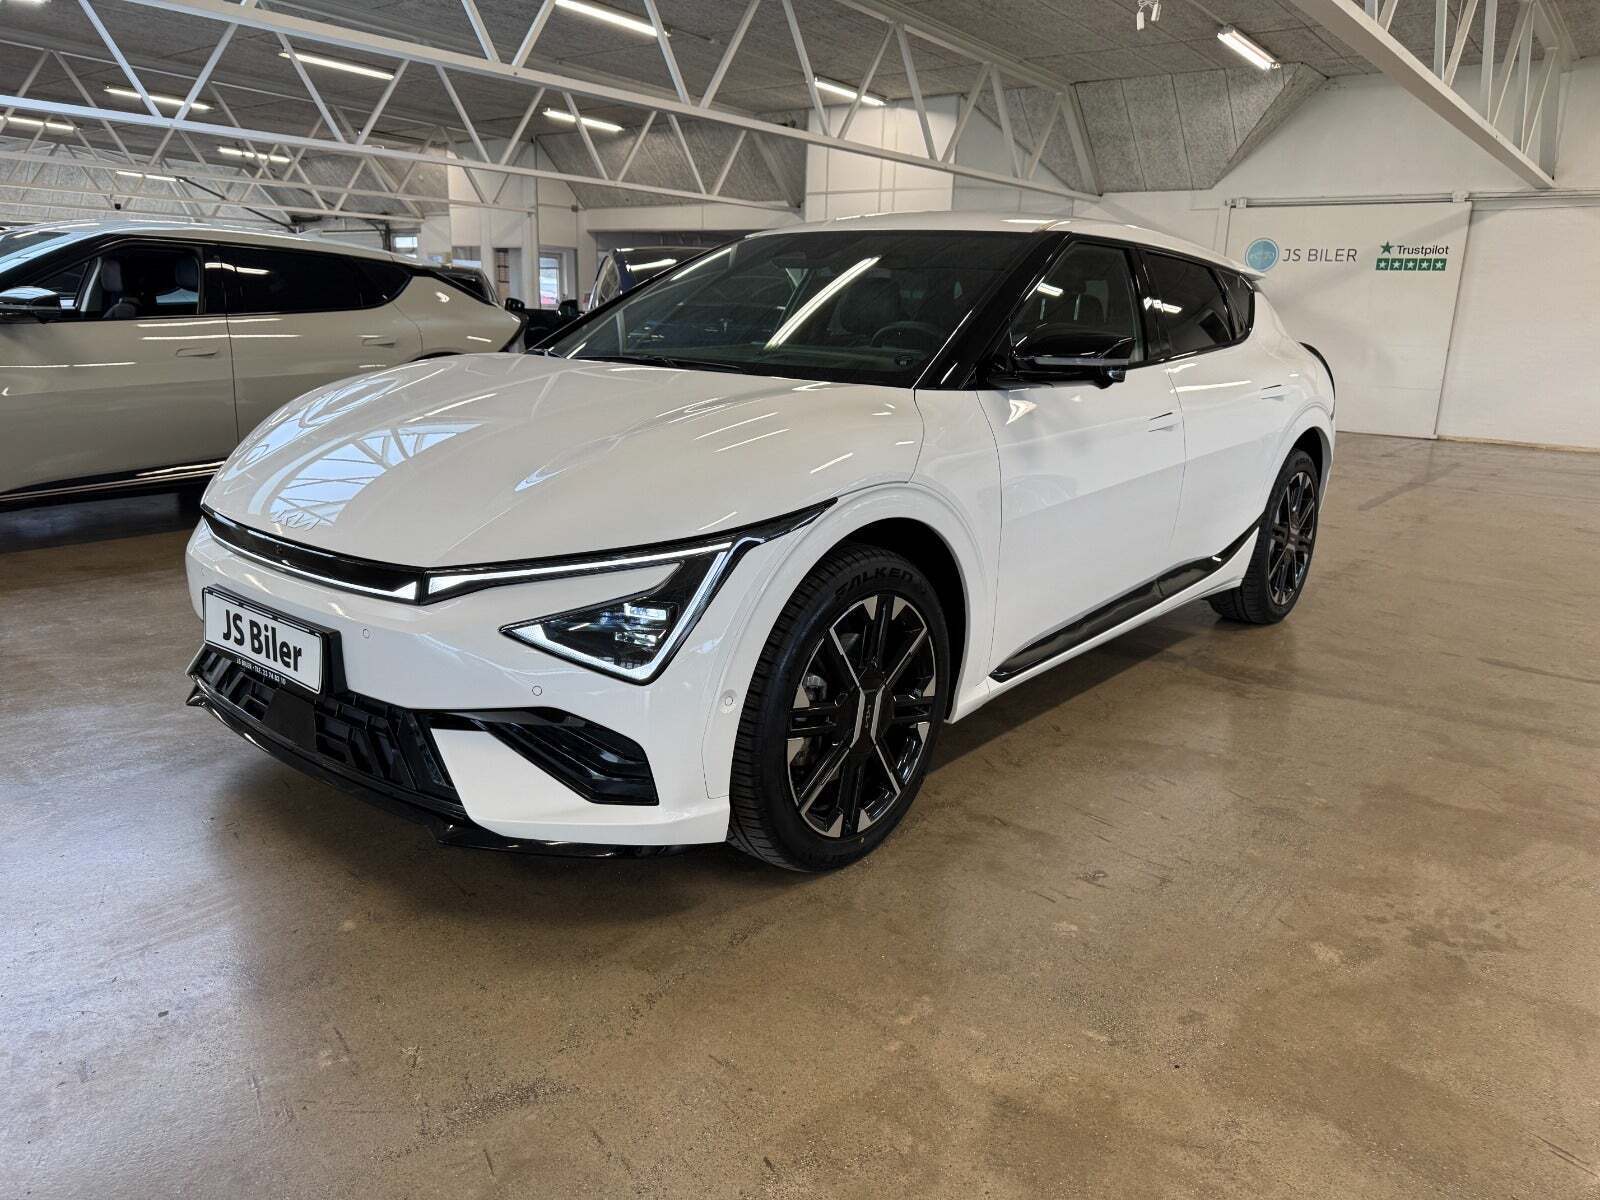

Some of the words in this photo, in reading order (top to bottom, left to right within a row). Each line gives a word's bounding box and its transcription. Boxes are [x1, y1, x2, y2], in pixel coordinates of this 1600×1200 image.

[1282, 248, 1301, 262] JS
[1307, 248, 1358, 262] BILER
[1397, 245, 1449, 256] Trustpilot
[223, 609, 245, 646] JS
[249, 619, 302, 672] Biler
